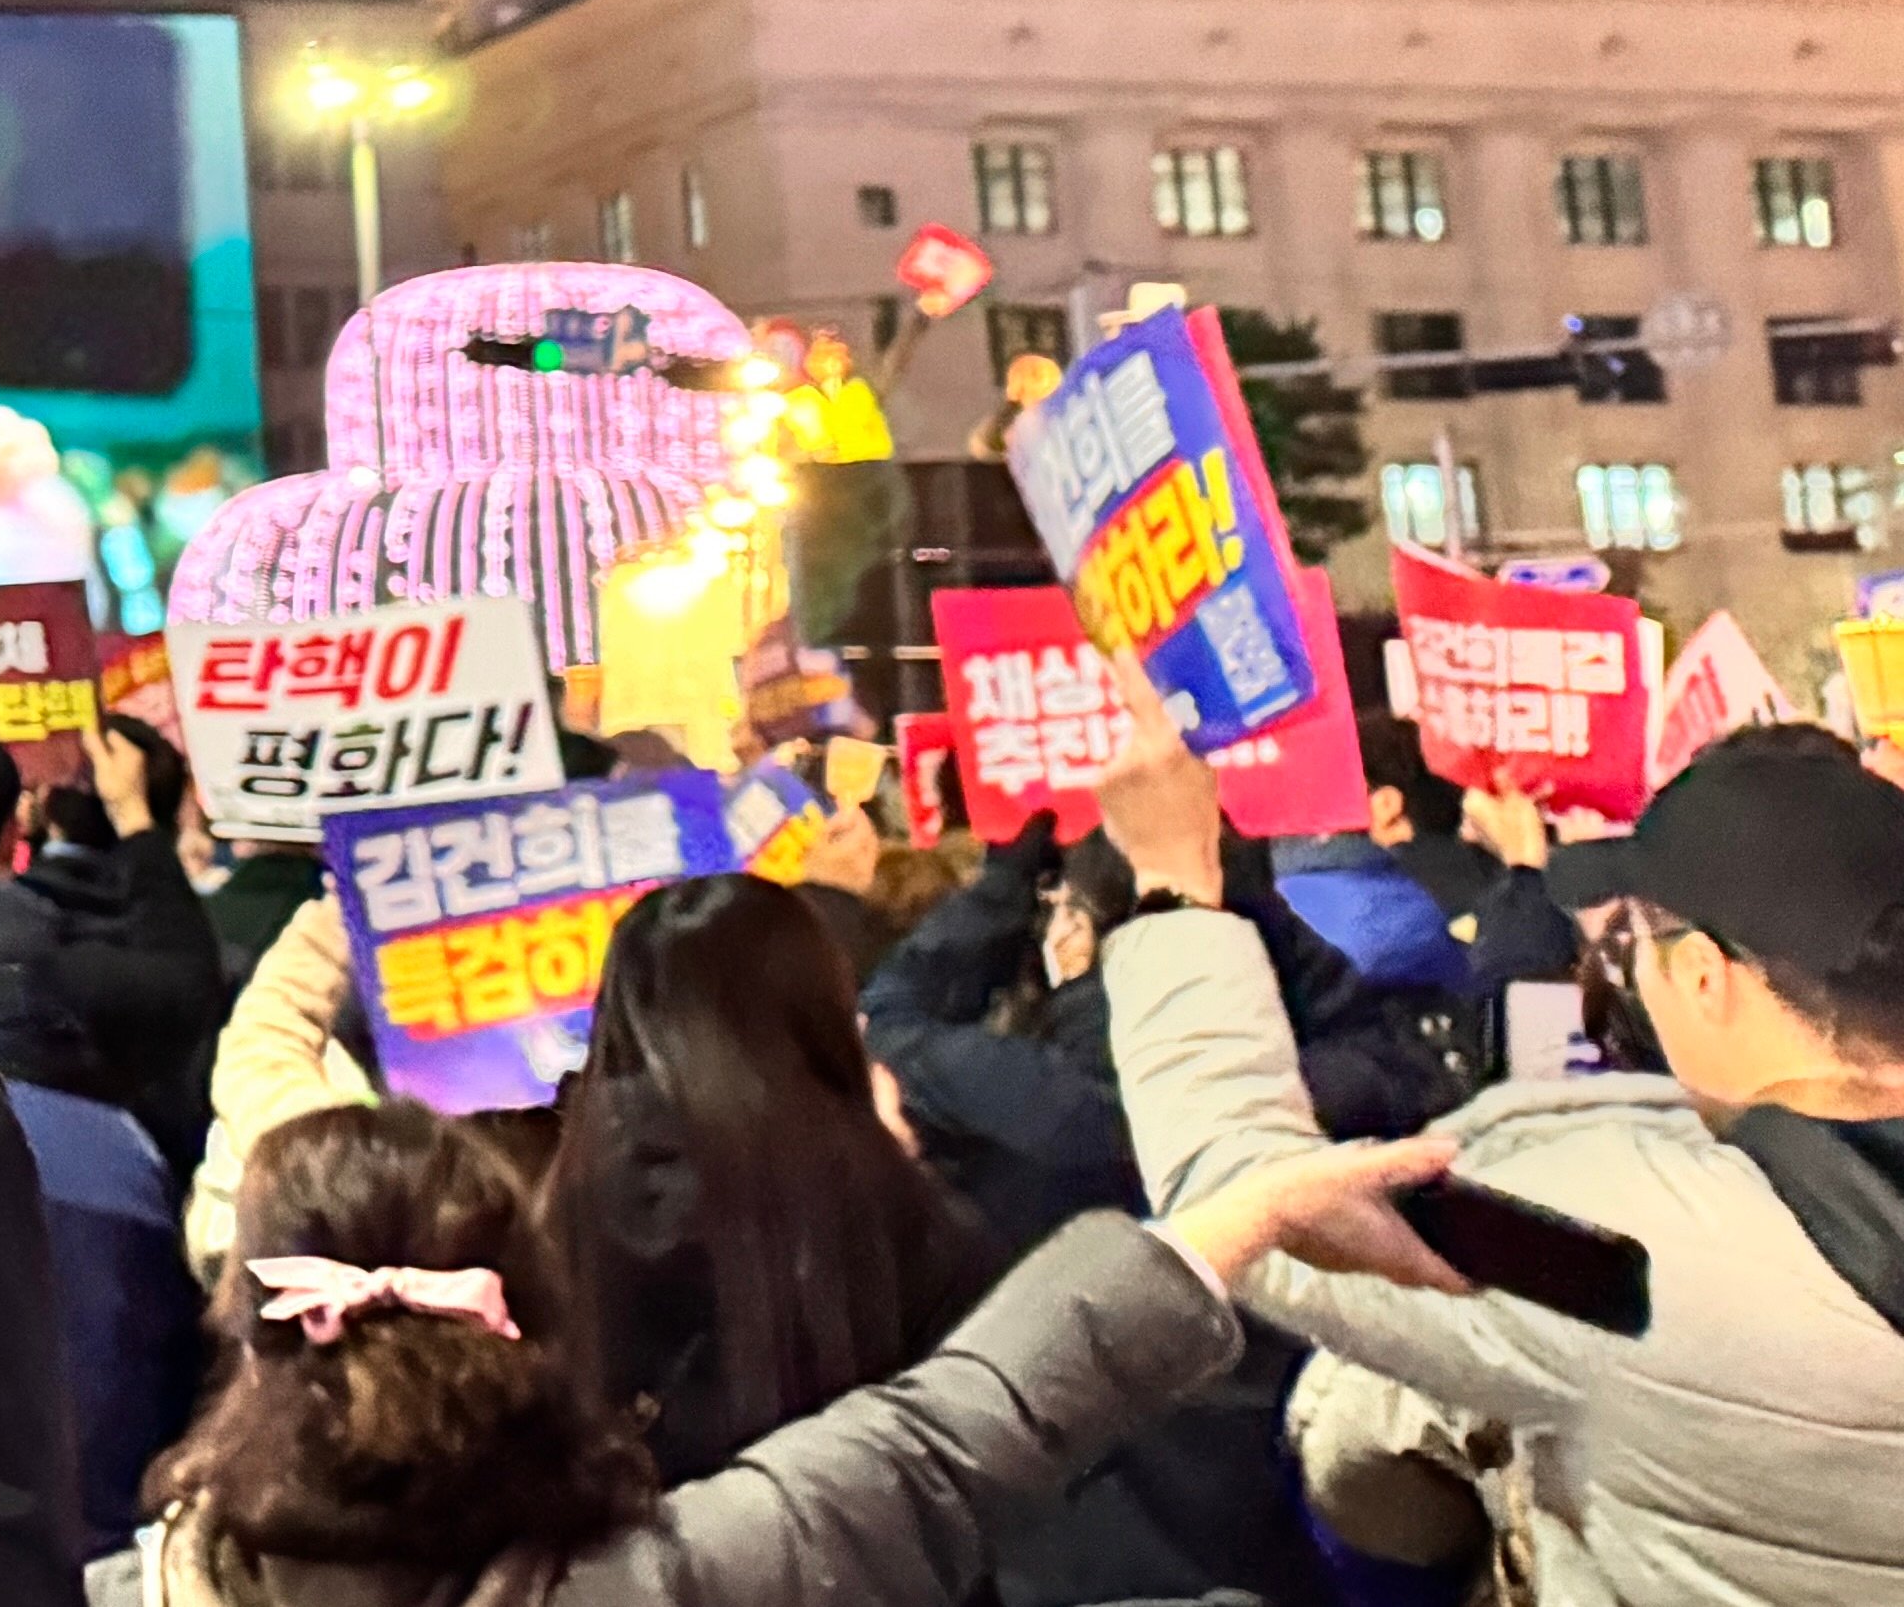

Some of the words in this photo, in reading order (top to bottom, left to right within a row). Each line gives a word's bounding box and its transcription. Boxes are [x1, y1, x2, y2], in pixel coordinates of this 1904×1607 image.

[196, 614, 466, 712] 탄핵이
[239, 701, 534, 798] 평화다!
[353, 793, 684, 932] 김건희를
[375, 895, 636, 1032] 특검하
